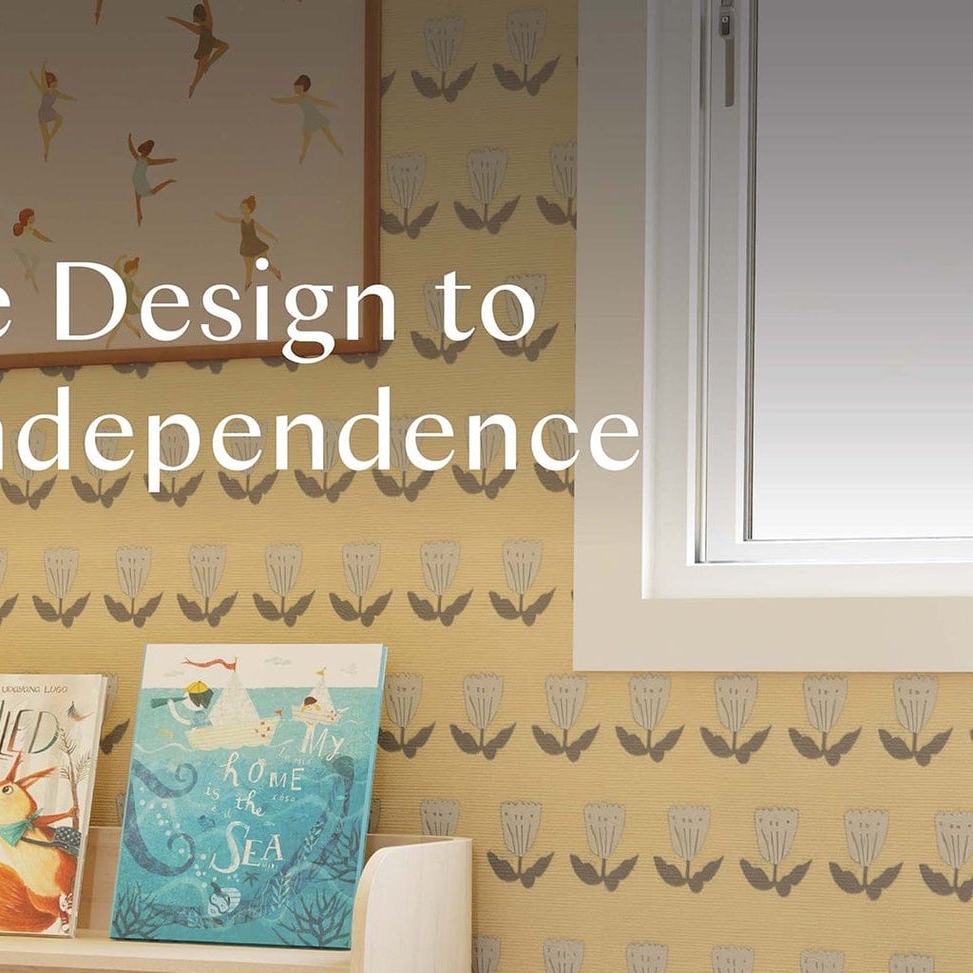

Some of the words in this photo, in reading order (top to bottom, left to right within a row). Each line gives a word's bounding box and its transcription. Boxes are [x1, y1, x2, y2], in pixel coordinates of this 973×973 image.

[301, 726, 345, 762] My
[204, 783, 220, 800] is
[235, 790, 267, 816] the
[209, 820, 284, 874] SEA
